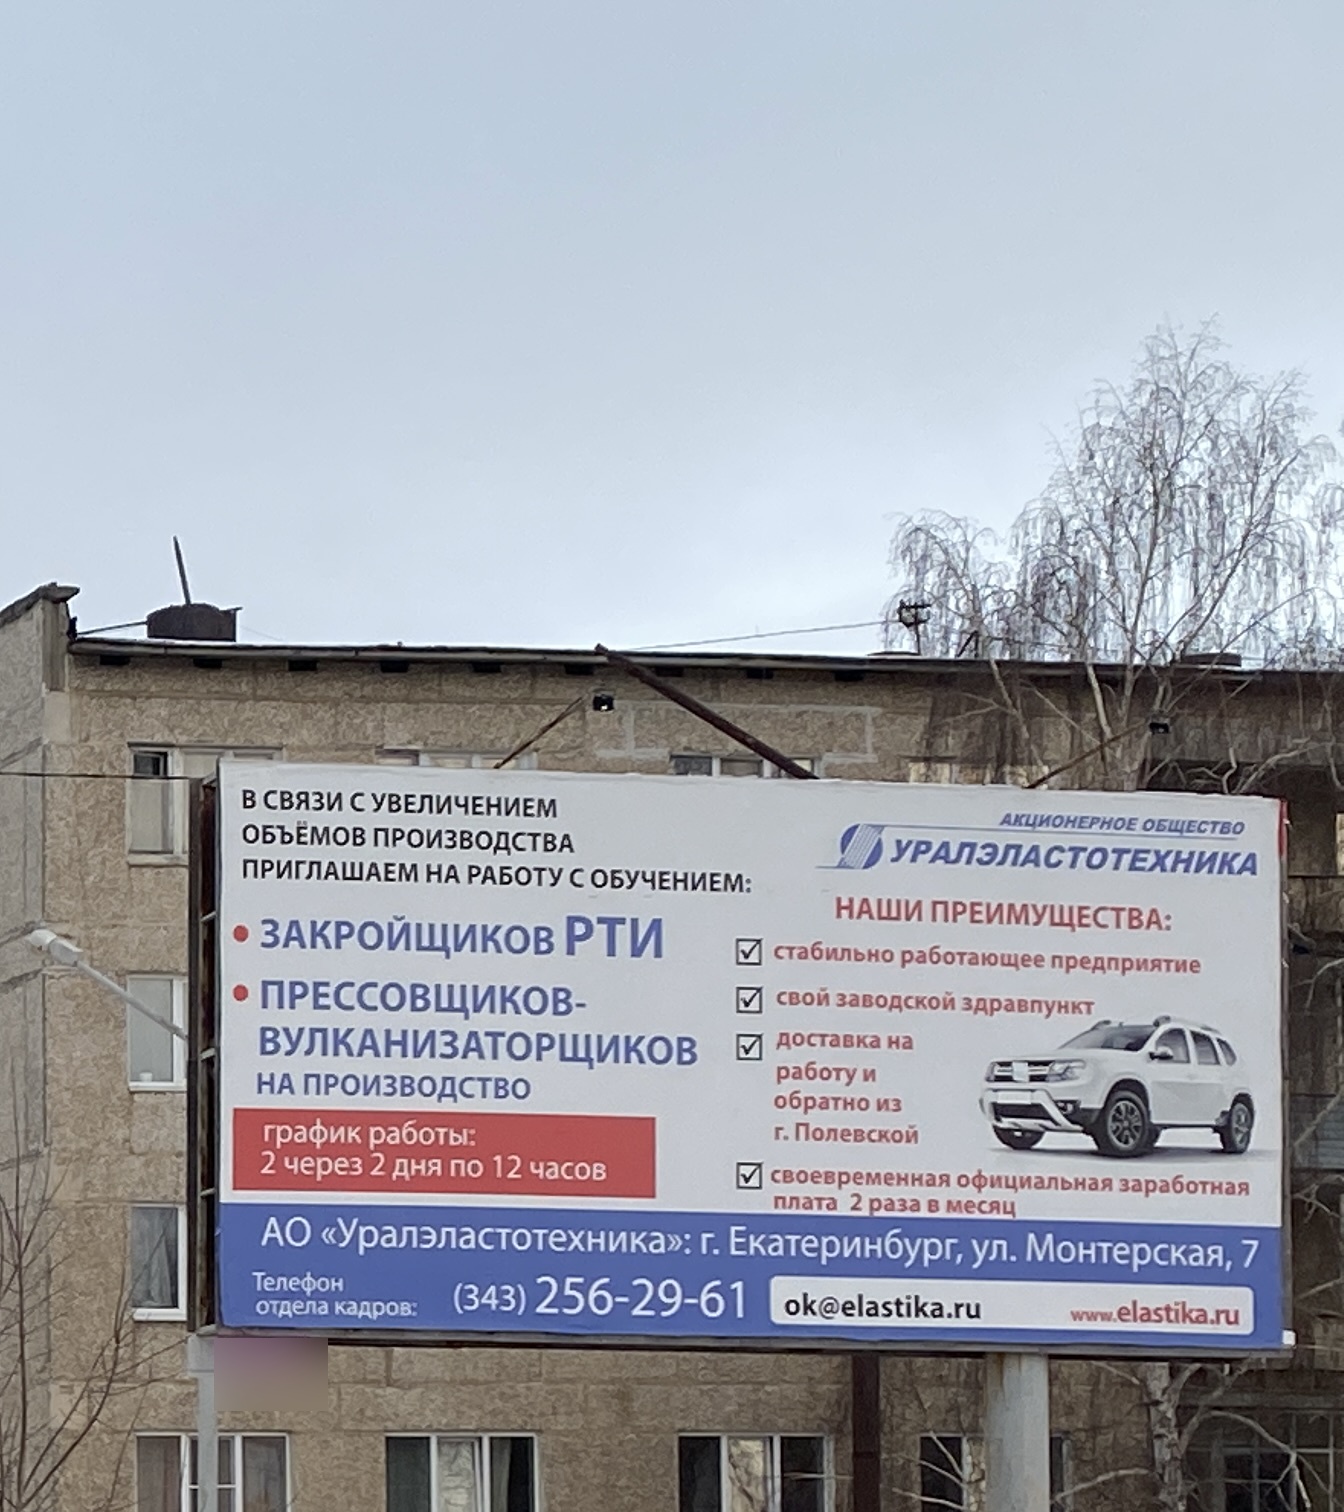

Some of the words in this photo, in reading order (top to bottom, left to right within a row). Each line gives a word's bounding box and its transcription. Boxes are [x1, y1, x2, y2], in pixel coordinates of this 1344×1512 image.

[242, 789, 257, 810] В
[263, 789, 343, 812] СВЯЗИ
[349, 792, 365, 813] С
[370, 792, 557, 819] УВЕЛИЧЕНИЕМ
[242, 821, 366, 847] ОБЪЁМОВ
[373, 827, 575, 856] ПРОИЗВОДСТВА
[998, 811, 1139, 834] АКЦИОНЕРНОЕ
[1141, 818, 1246, 836] ОБЩЕСТВО
[890, 837, 1258, 876] УРАЛЭЛАСТОТЕХНИКА
[242, 858, 419, 883] ПРИГЛАШАЕМ
[425, 863, 461, 884] НА
[467, 864, 564, 888] РАБОТУ
[569, 867, 585, 889] С
[590, 868, 751, 893] ОБУЧЕНИЕМ:
[835, 896, 923, 922] НАШИ
[930, 900, 1172, 933] ПРЕИМУЩЕСТВА:
[260, 915, 555, 960] ЗАКРОЙЩИКОВ
[565, 915, 663, 959] РТИ
[773, 940, 895, 964] стабильно
[900, 945, 1046, 972] работающее
[1050, 954, 1201, 977] предприятие
[261, 979, 587, 1021] ПРЕССОВЩИКОВ-
[776, 987, 830, 1007] свой
[835, 991, 956, 1014] заводской
[961, 996, 1096, 1020] здравпункт
[259, 1026, 698, 1070] ВУЛКАНИЗАТОРЩИКОВ
[775, 1032, 881, 1051] доставка
[887, 1035, 914, 1050] на
[256, 1072, 296, 1096] НА
[303, 1073, 531, 1104] ПРОИЗВОДСТВО
[776, 1060, 858, 1087] работу
[862, 1068, 876, 1083] и
[773, 1089, 870, 1116] обратно
[876, 1097, 902, 1113] из
[264, 1117, 362, 1150] график
[369, 1119, 476, 1151] работы:
[774, 1126, 790, 1141] г.
[795, 1122, 919, 1145] Полевской
[260, 1150, 276, 1174] 2
[284, 1156, 363, 1182] через
[369, 1151, 386, 1176] 2
[392, 1158, 442, 1181] дня
[450, 1159, 484, 1178] по
[492, 1154, 522, 1179] 12
[529, 1161, 607, 1181] часов
[770, 1169, 951, 1191] своевременная
[956, 1168, 1114, 1194] официальная
[1118, 1174, 1250, 1198] заработная
[773, 1195, 838, 1211] плата
[850, 1192, 863, 1212] 2
[867, 1197, 922, 1217] раза
[927, 1198, 940, 1214] в
[946, 1199, 1016, 1218] месяц
[261, 1216, 312, 1247] АО
[321, 1217, 691, 1256] «Уралэластотехника»:
[700, 1232, 720, 1255] г.
[729, 1225, 963, 1268] Екатеринбург,
[971, 1238, 1017, 1269] ул.
[1026, 1232, 1232, 1273] Монтерская,
[1241, 1239, 1259, 1268] 7
[251, 1271, 344, 1297] Телефон
[453, 1282, 526, 1316] (343)
[535, 1276, 744, 1318] 256-29-61
[255, 1296, 329, 1319] отдела
[334, 1300, 417, 1321] кадров:
[784, 1292, 981, 1320] ok@elastika.ru
[1070, 1299, 1240, 1326] www.elastika.ru
